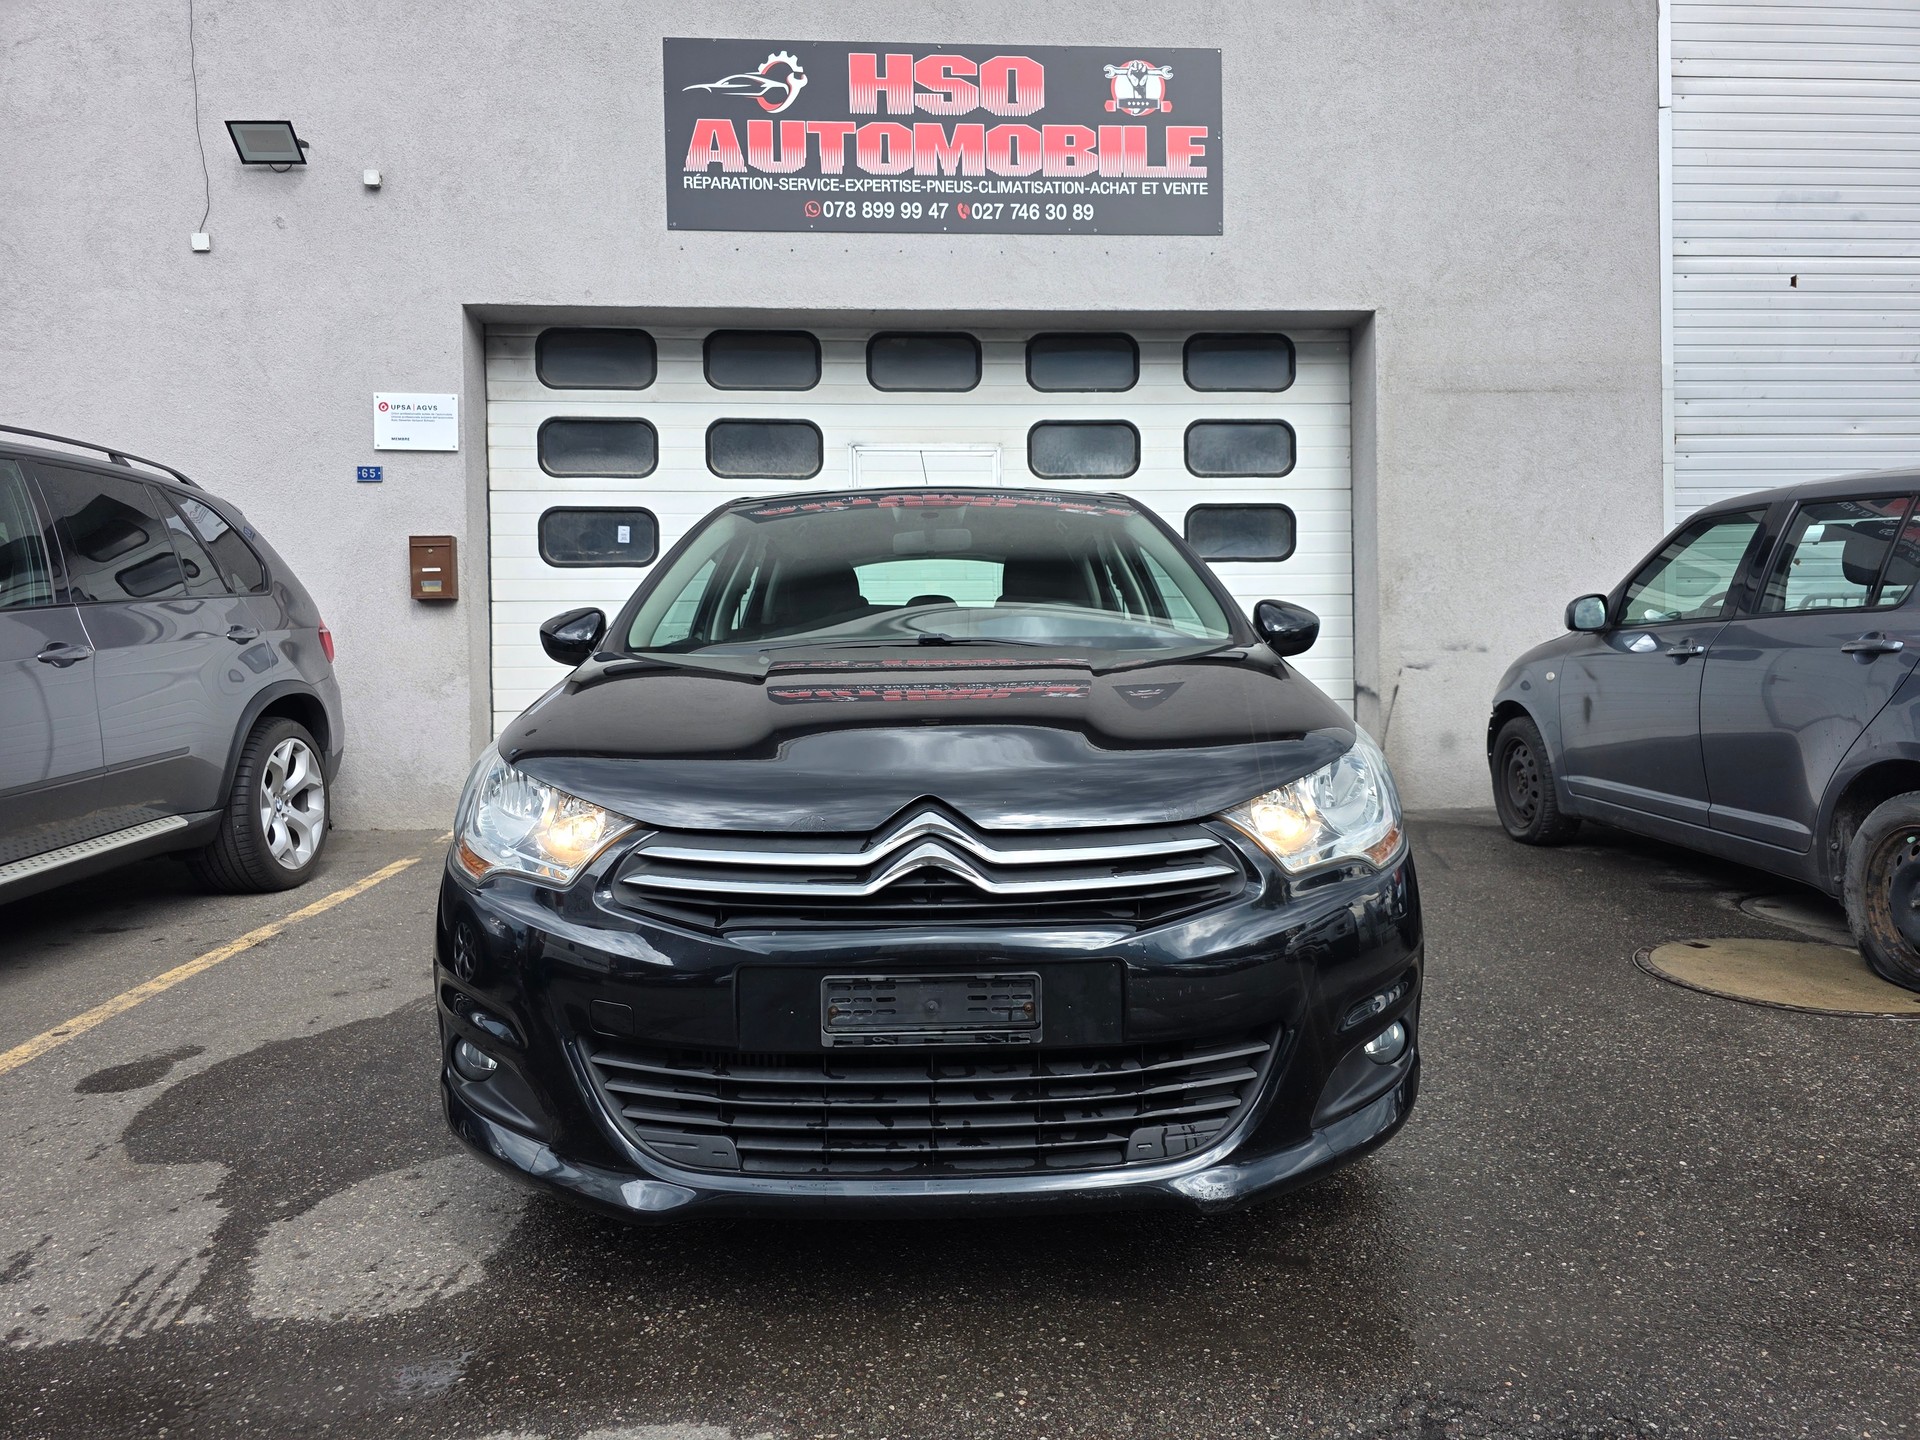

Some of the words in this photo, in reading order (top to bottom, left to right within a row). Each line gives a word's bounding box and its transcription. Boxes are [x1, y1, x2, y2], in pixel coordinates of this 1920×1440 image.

[848, 52, 1045, 117] HSO
[683, 118, 1208, 179] AUTOMOBILE
[1141, 182, 1159, 195] ET
[1162, 182, 1208, 195] VENTE
[822, 201, 857, 218] 078
[861, 201, 895, 219] 899
[900, 202, 923, 219] 99
[928, 202, 949, 219] 47
[971, 203, 1004, 220] 027
[1010, 203, 1040, 220] 746
[1045, 203, 1067, 220] 30
[1072, 204, 1094, 220] 89
[361, 468, 376, 478] 65
